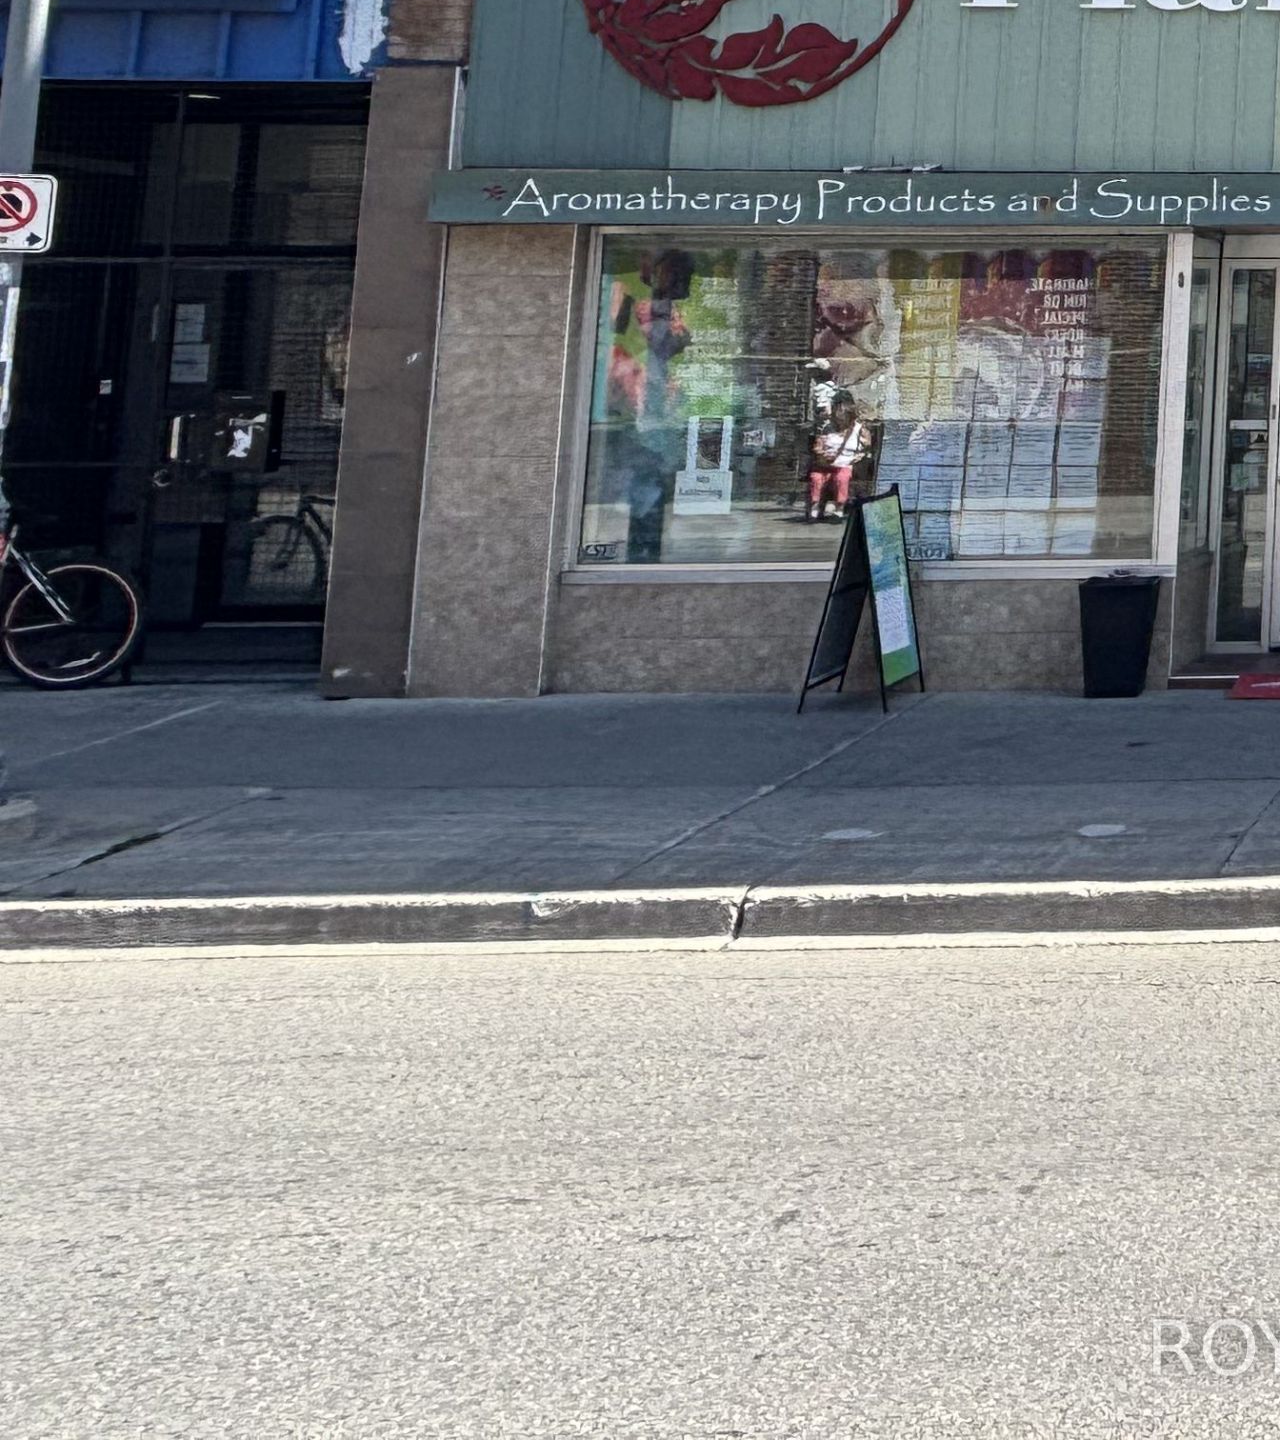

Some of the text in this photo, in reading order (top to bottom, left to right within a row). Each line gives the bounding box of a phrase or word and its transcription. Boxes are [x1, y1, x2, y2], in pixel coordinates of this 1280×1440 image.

[502, 177, 1272, 225] Aromatherapy Products and Supplies
